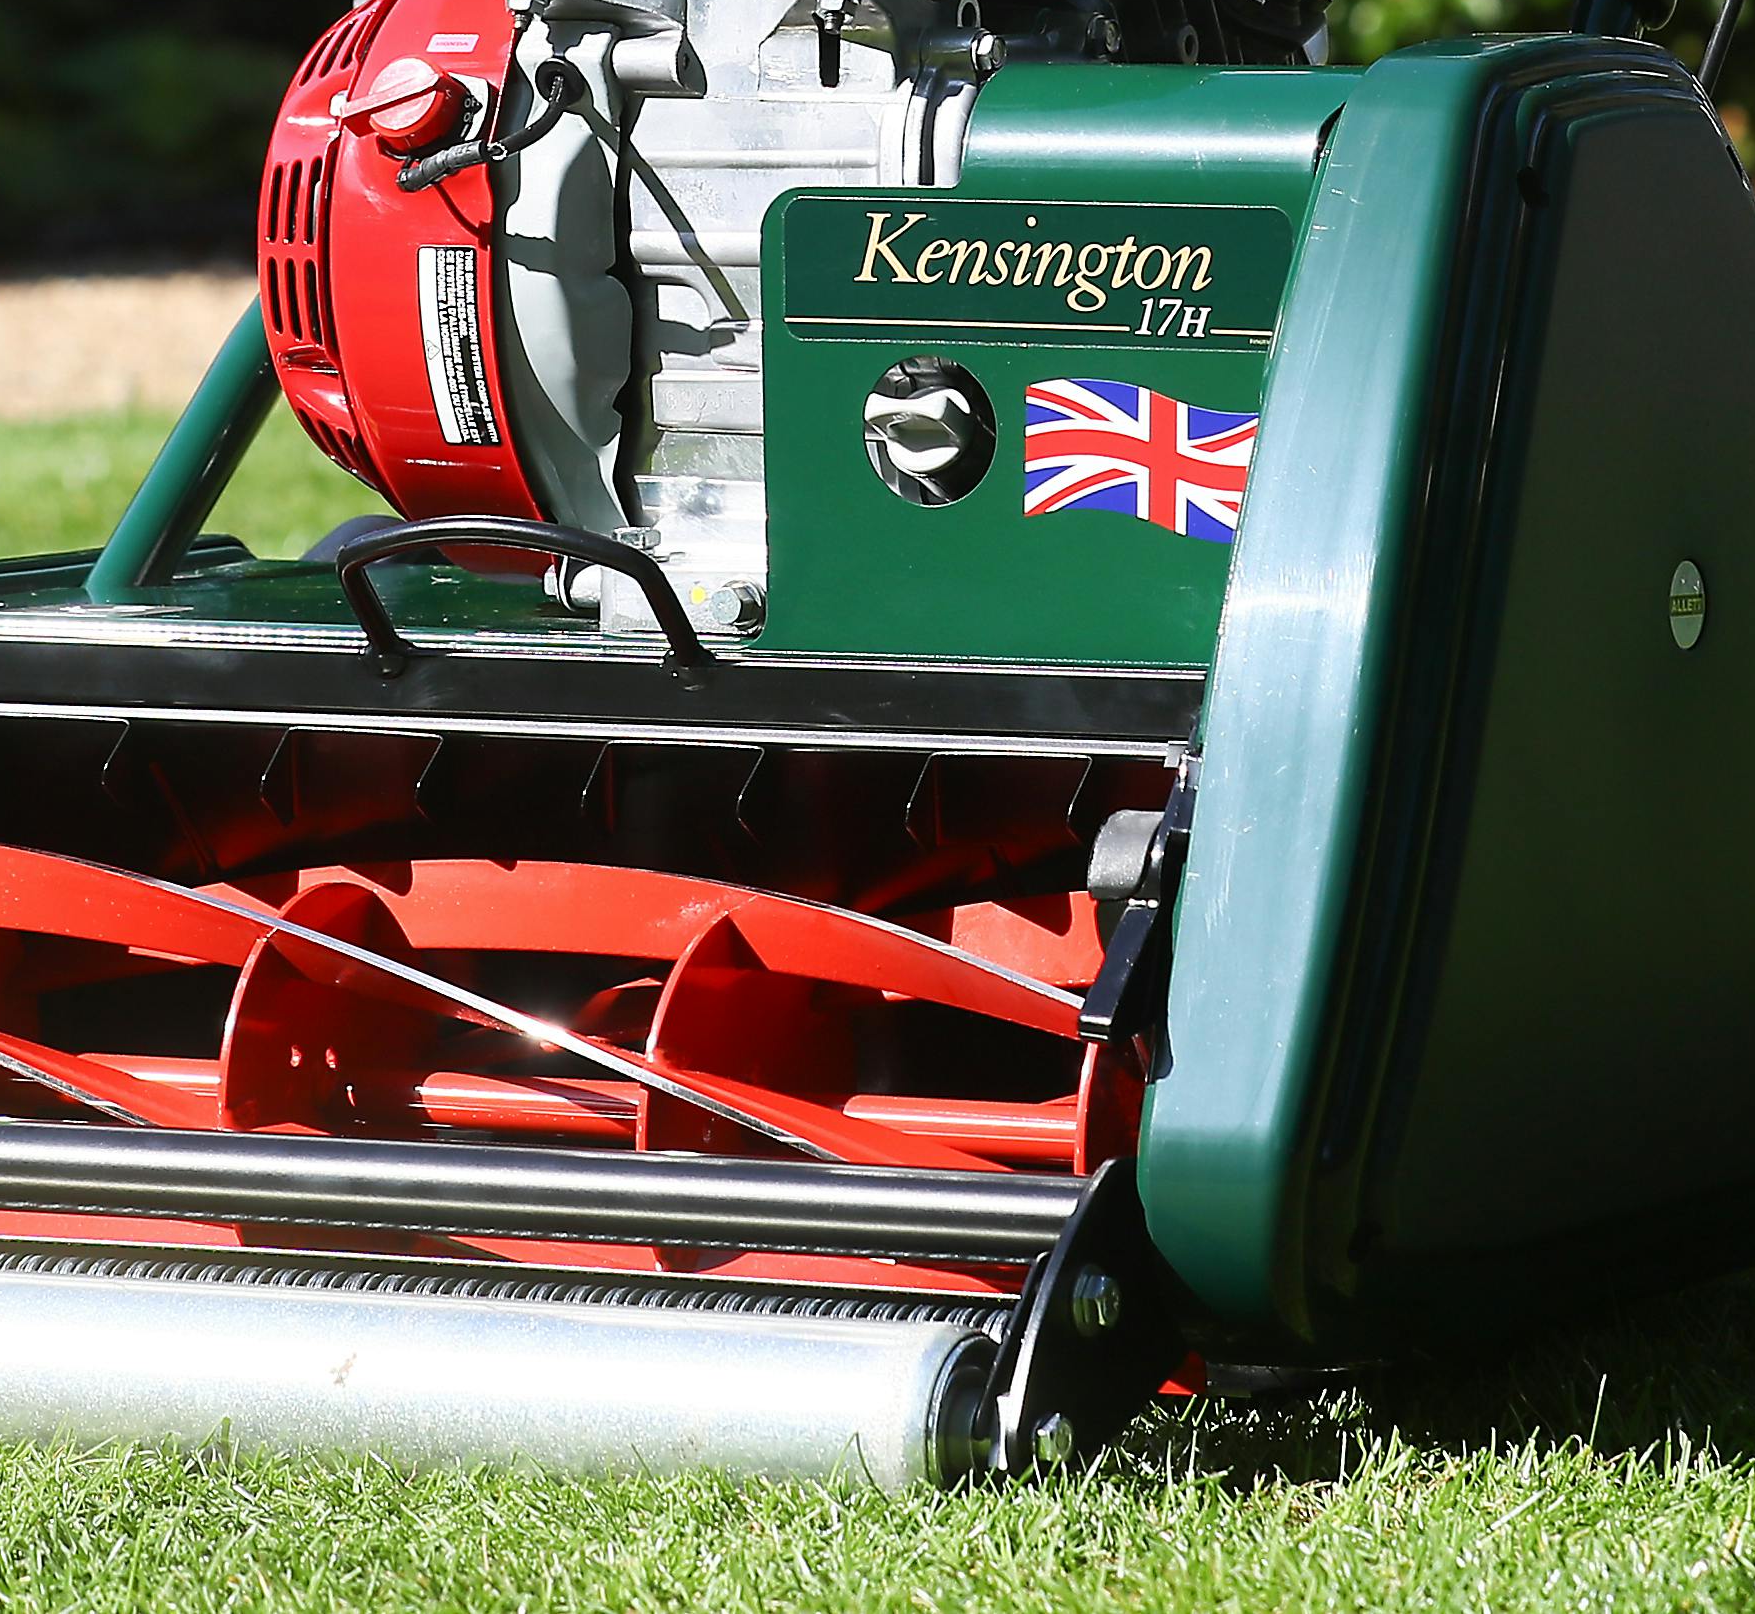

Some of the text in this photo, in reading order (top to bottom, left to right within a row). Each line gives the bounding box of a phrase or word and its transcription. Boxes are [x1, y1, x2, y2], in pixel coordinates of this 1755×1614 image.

[436, 250, 447, 301] CONFORME
[456, 250, 465, 297] CANADIAN
[854, 212, 1213, 312] Kensington
[439, 311, 449, 323] LA
[440, 324, 452, 356] NORME
[1134, 297, 1212, 337] 17H
[446, 250, 455, 263] CE
[454, 365, 466, 383] PAR
[469, 429, 481, 444] EST
[465, 250, 499, 442] THIS SPARK IGNITION SYSTEM COMPLIES WITH
[451, 393, 461, 406] DU
